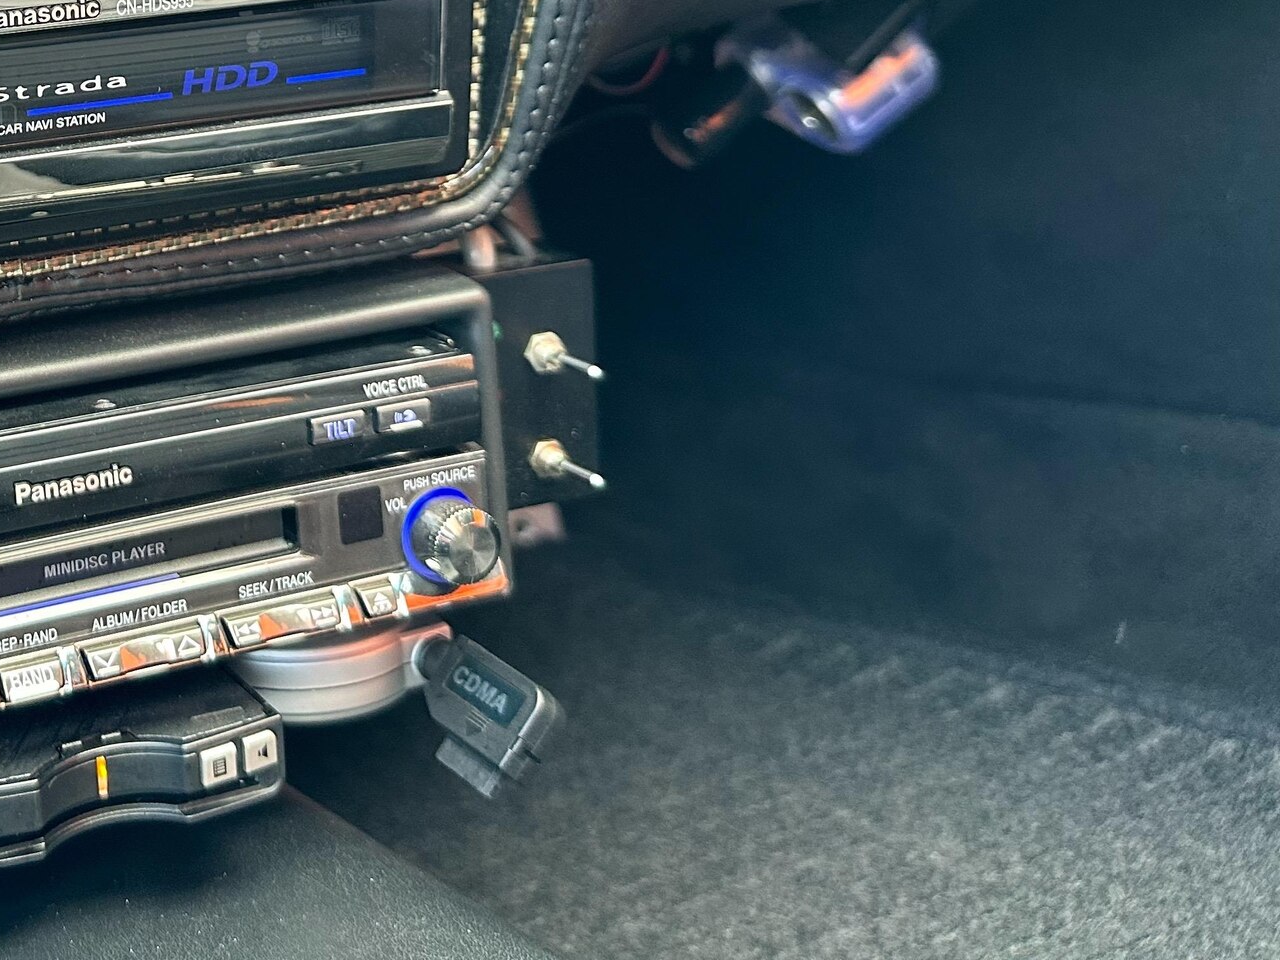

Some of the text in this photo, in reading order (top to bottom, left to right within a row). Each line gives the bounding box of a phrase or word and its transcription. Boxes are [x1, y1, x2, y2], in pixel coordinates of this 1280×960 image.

[182, 60, 280, 97] HDD
[26, 118, 53, 133] NAVI
[56, 112, 106, 128] STATION
[363, 374, 429, 398] VOICE CTRL
[323, 418, 356, 440] TILT
[14, 464, 134, 506] Panasonic
[403, 465, 476, 491] PUSH SOURCE
[385, 496, 407, 513] VOL
[44, 541, 166, 579] MINIDISC PLAYER
[238, 570, 315, 599] SEEK/TRACK
[92, 598, 188, 632] ALBUM/FOLDER
[9, 665, 55, 690] BAND
[452, 665, 509, 716] CDMA
